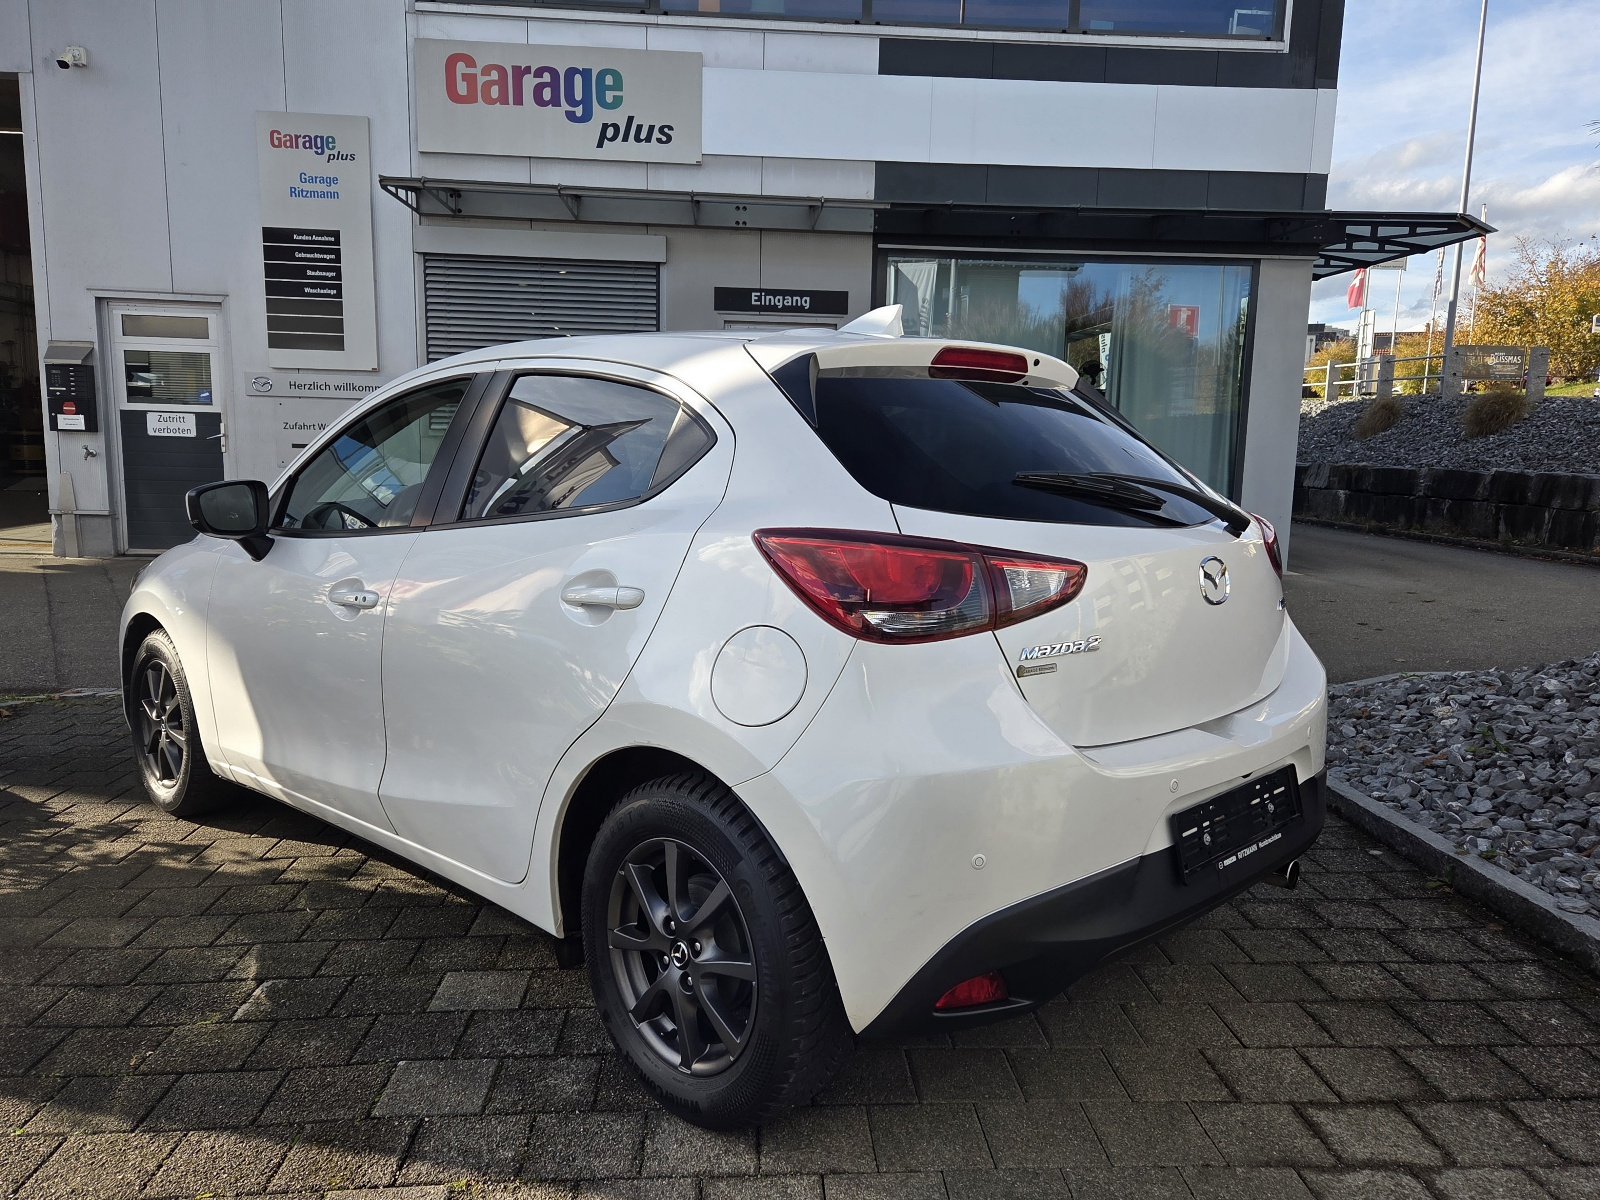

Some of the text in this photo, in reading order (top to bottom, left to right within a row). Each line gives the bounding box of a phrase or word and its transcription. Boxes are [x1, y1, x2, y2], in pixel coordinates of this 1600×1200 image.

[444, 52, 624, 124] Garage
[595, 115, 675, 149] plus
[269, 129, 337, 156] Garage
[326, 150, 356, 164] plus
[299, 172, 339, 188] Garage
[289, 186, 340, 200] Ritzmann
[294, 251, 336, 260] Gebrauchtwagen
[306, 269, 336, 278] Staubsauger
[303, 287, 337, 295] Waschanlage
[751, 291, 811, 310] Eingang
[288, 380, 331, 391] Herzlich
[157, 414, 186, 424] Zutritt
[152, 426, 192, 436] verboten
[282, 421, 316, 431] Zufahrt
